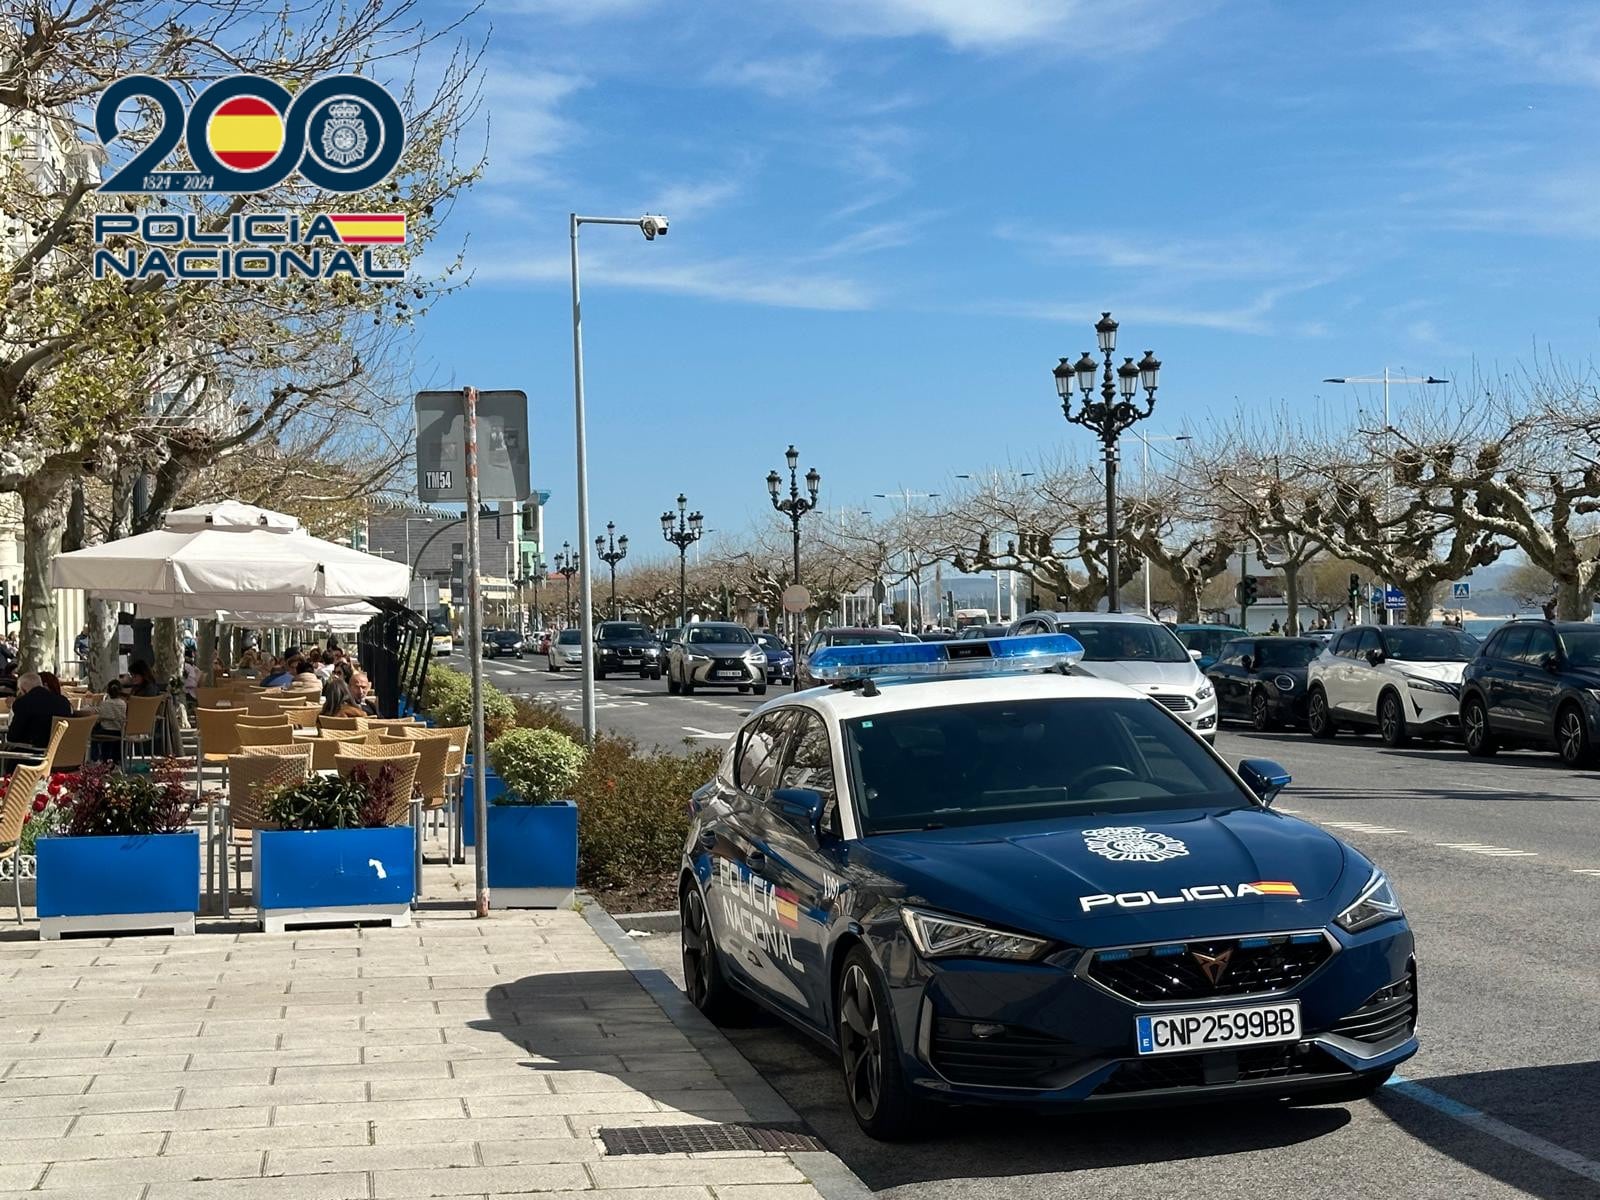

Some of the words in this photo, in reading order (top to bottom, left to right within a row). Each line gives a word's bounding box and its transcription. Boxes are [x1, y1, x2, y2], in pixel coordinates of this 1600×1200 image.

[426, 471, 452, 489] TM54
[722, 895, 805, 973] NACIONAL
[1153, 1007, 1296, 1047] CNP2599BB
